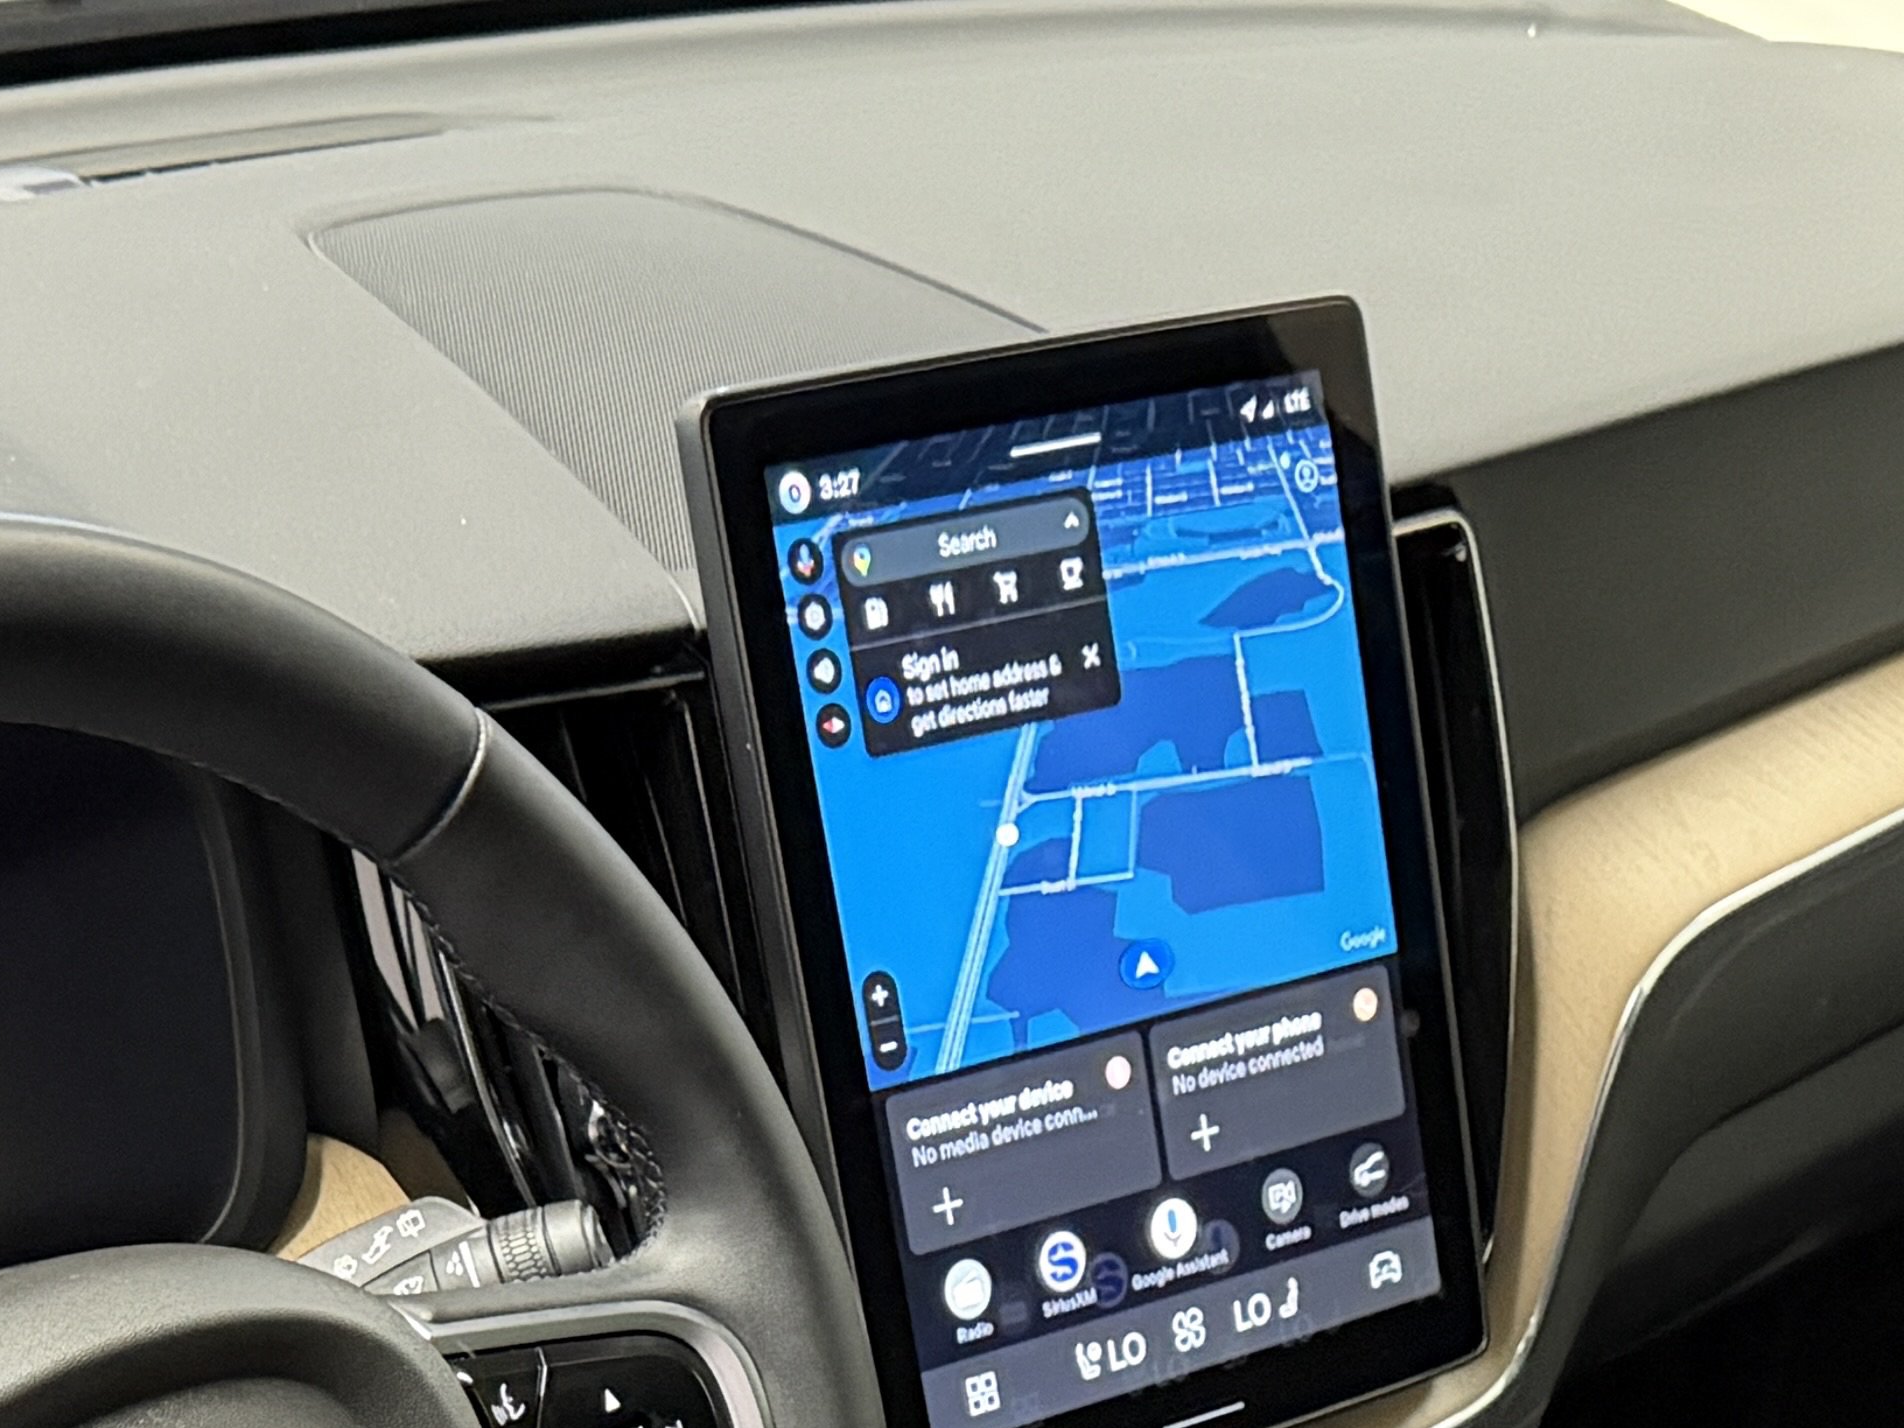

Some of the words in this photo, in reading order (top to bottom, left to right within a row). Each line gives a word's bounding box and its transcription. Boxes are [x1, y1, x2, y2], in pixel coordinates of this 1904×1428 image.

[1283, 386, 1311, 414] LTE
[818, 466, 861, 501] 3:27
[937, 526, 998, 558] Search
[901, 650, 941, 682] Sign
[940, 645, 960, 673] in
[906, 686, 925, 706] to
[925, 678, 950, 703] set
[949, 671, 992, 697] home
[992, 659, 1049, 688] address
[910, 709, 938, 738] get
[937, 696, 1008, 728] directions
[1007, 686, 1050, 713] faster
[1338, 925, 1387, 953] Google
[1166, 1031, 1235, 1070] Connect
[1234, 1024, 1272, 1057] your
[1271, 1010, 1324, 1046] phone
[1171, 1073, 1197, 1097] No
[1197, 1060, 1247, 1090] device
[1247, 1034, 1325, 1077] connected
[906, 1101, 980, 1142] Connect
[977, 1094, 1019, 1127] your
[1018, 1079, 1075, 1112] device
[910, 1146, 939, 1169] No
[938, 1130, 991, 1161] media
[991, 1117, 1044, 1147] device
[1338, 1206, 1371, 1230] Drive
[1370, 1193, 1411, 1222] modes
[1264, 1223, 1313, 1252] Camera
[1130, 1266, 1175, 1294] Google
[1174, 1248, 1230, 1280] Assistant
[1040, 1286, 1098, 1320] SiriusXM
[1233, 1291, 1273, 1334] LO
[955, 1320, 995, 1345] Radio
[1107, 1330, 1148, 1372] LO
